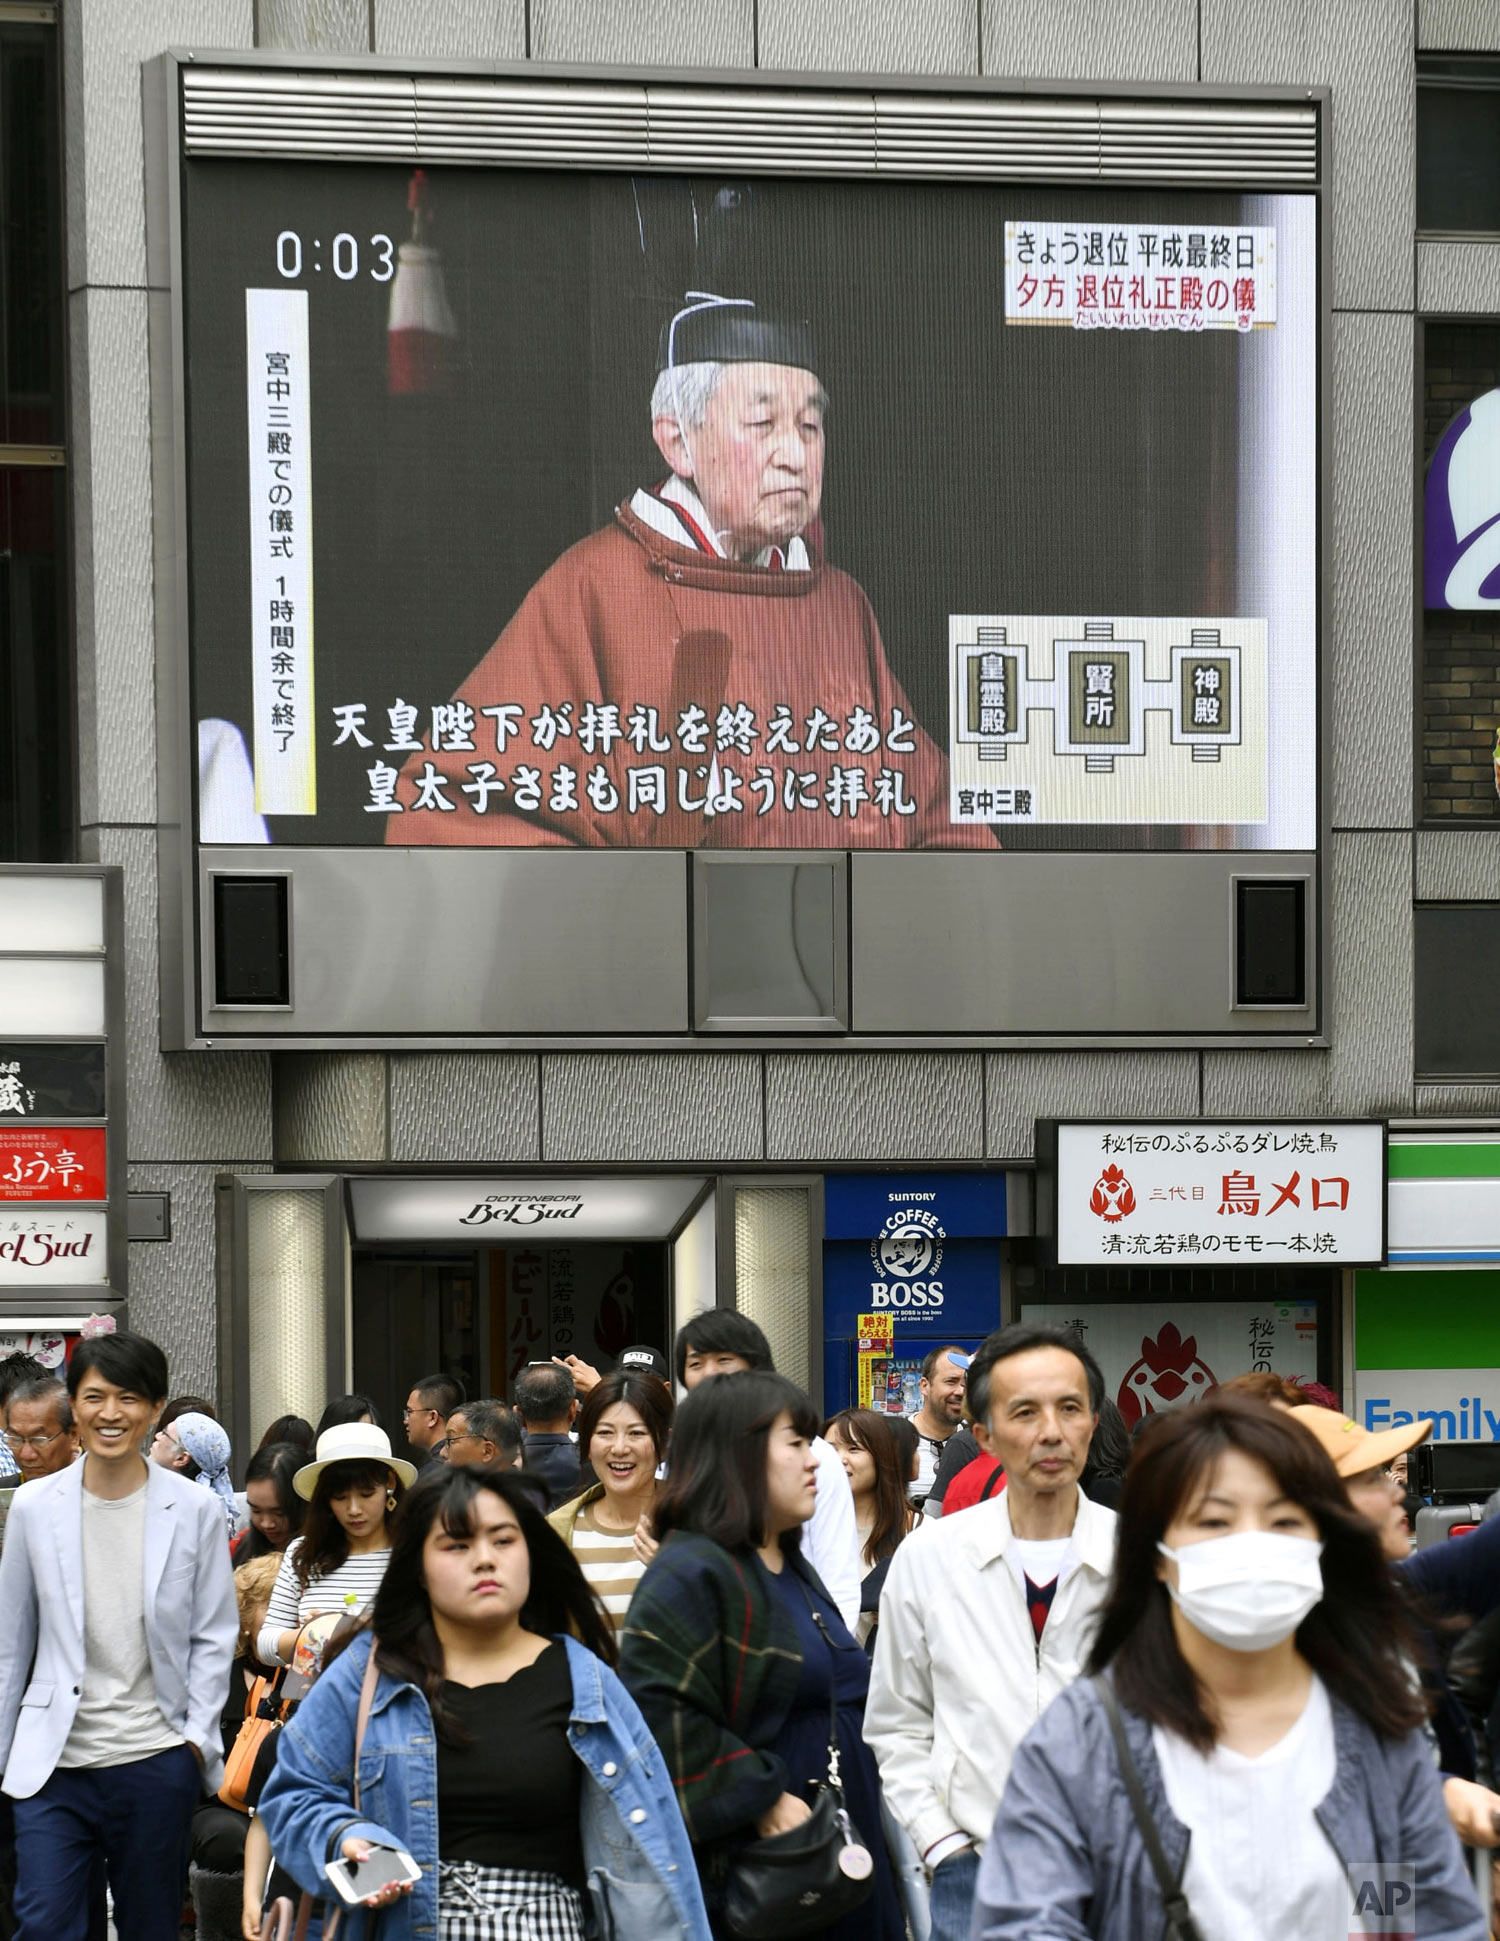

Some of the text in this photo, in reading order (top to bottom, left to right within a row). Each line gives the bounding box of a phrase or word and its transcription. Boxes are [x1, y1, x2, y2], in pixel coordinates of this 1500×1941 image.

[276, 230, 394, 282] 0:03
[1016, 231, 1254, 269] きょう退位 平成最終日
[1016, 273, 1256, 312] 夕方 退位礼正殿の儀
[265, 352, 296, 753] 宮中三殿での儀式 1時間余で終了
[979, 652, 1006, 735] 皇霊殿
[1085, 664, 1115, 727] 賢所
[1194, 667, 1220, 725] 神殿
[332, 698, 916, 755] 天皇陛下が拝礼を終えたあと
[363, 760, 917, 818] 皇太子さまも同じように拝礼
[958, 789, 1032, 816] 宮中三殿
[1101, 1131, 1339, 1154] 秘伝のぷるぷるダレ焼鳥
[485, 1195, 581, 1203] DOTONBORI
[1149, 1169, 1350, 1217] 三代目 鳥メロ
[886, 1208, 939, 1230] COFFEE
[1101, 1232, 1339, 1255] 清流若鶏のモモ一本焼
[871, 1281, 945, 1308] BOSS
[863, 1316, 888, 1328] 絶対
